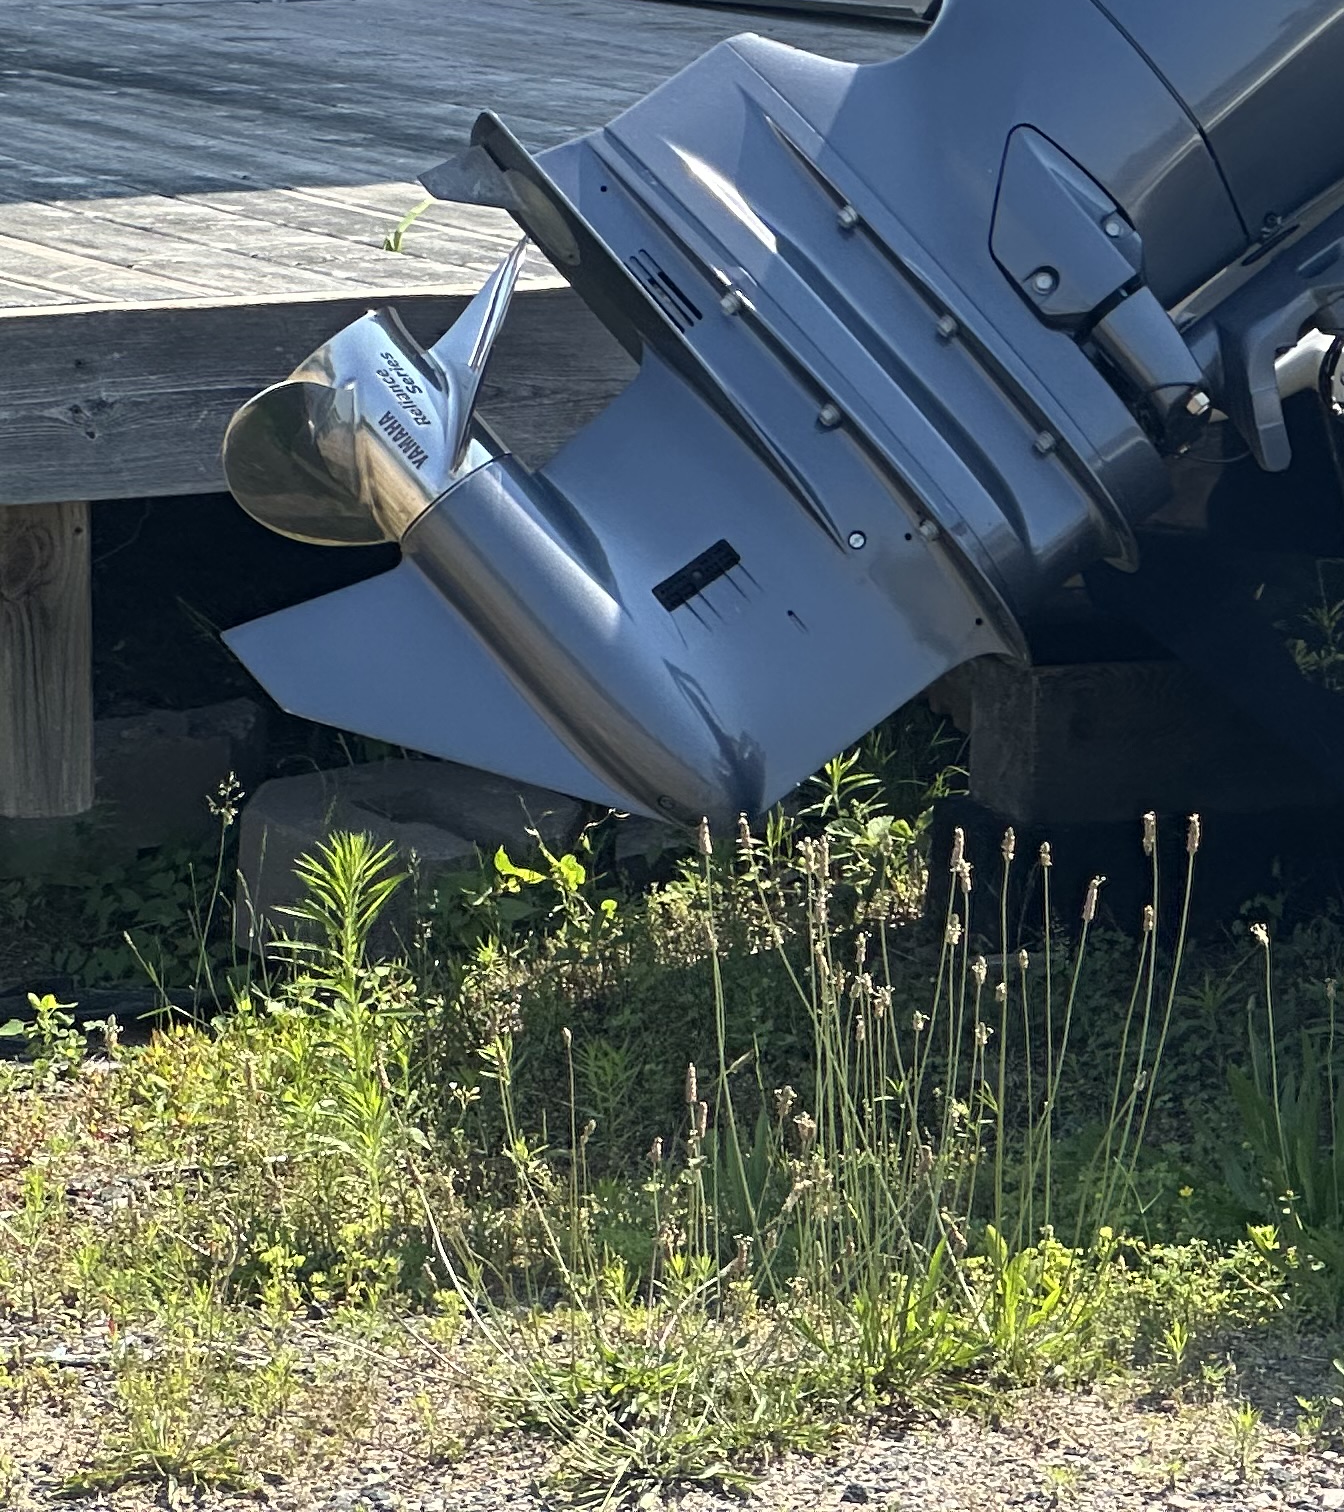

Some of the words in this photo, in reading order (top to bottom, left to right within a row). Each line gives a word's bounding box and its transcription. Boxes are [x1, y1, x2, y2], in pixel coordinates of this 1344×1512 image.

[376, 368, 432, 426] Reliance
[380, 351, 424, 394] Series
[378, 410, 429, 470] YAMAHA
